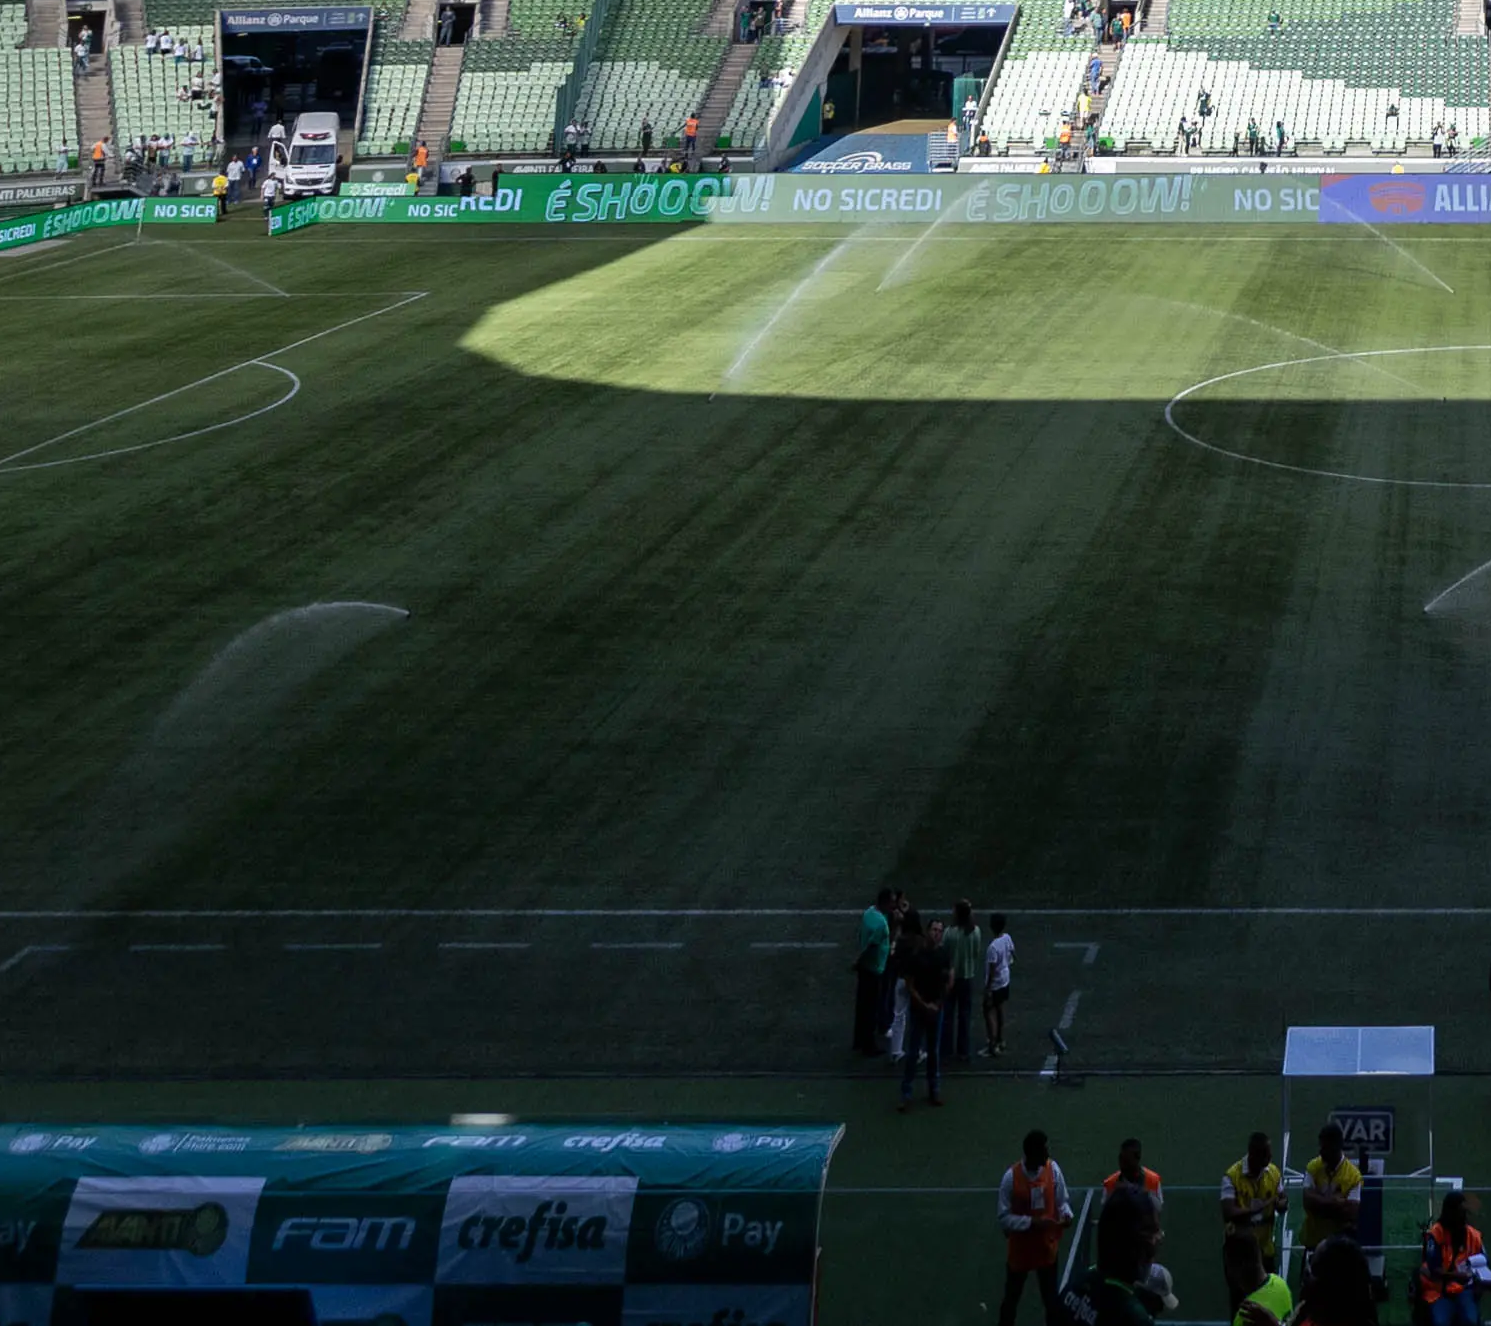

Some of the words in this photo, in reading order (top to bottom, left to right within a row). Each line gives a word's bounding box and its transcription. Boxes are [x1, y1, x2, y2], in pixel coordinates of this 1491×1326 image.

[227, 15, 266, 26] Allianz
[283, 13, 319, 27] Parque
[854, 8, 893, 18] Allianz
[909, 7, 945, 20] Parque
[802, 161, 861, 172] SOCCER
[866, 161, 912, 172] GRASS
[16, 185, 76, 200] PALMEIRAS
[359, 183, 407, 196] Sicredi
[793, 188, 835, 211] NO
[839, 188, 942, 211] SICREDI
[1234, 188, 1271, 211] NO
[154, 203, 176, 219] NO
[408, 204, 431, 218] NO
[1335, 1115, 1388, 1143] VAR
[563, 1132, 668, 1153] crefisa
[756, 1135, 796, 1151] Pay
[457, 1200, 608, 1265] crefisa
[722, 1212, 785, 1256] Pay
